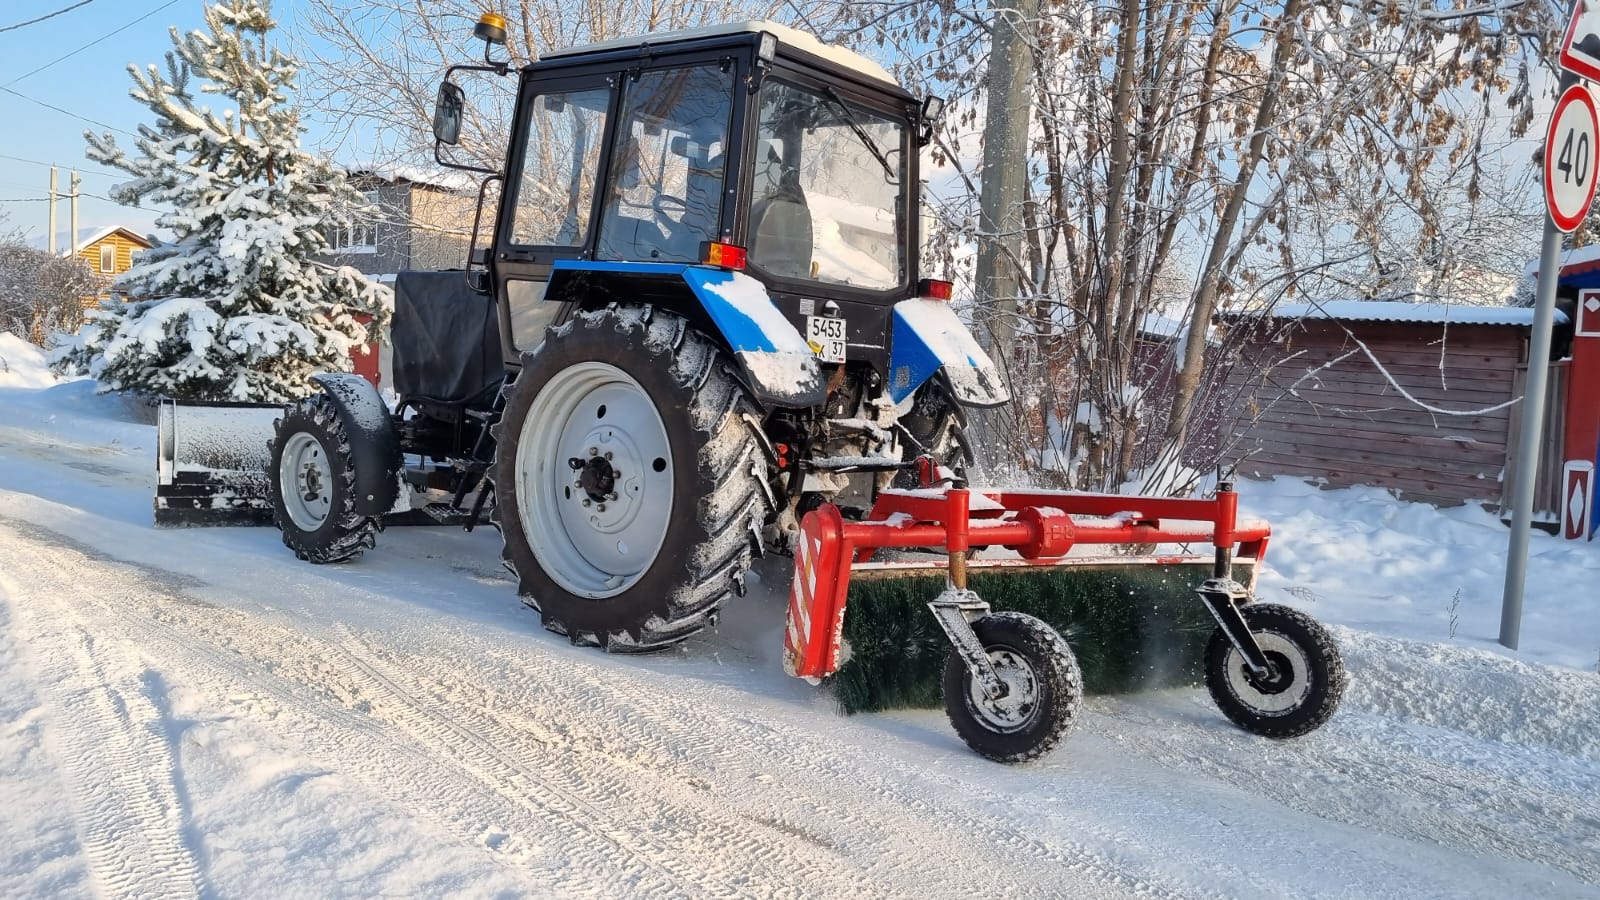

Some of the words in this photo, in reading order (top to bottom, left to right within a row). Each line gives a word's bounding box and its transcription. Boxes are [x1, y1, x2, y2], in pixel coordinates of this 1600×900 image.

[1558, 128, 1589, 187] 40
[812, 318, 842, 338] 5453
[832, 341, 843, 356] 37
